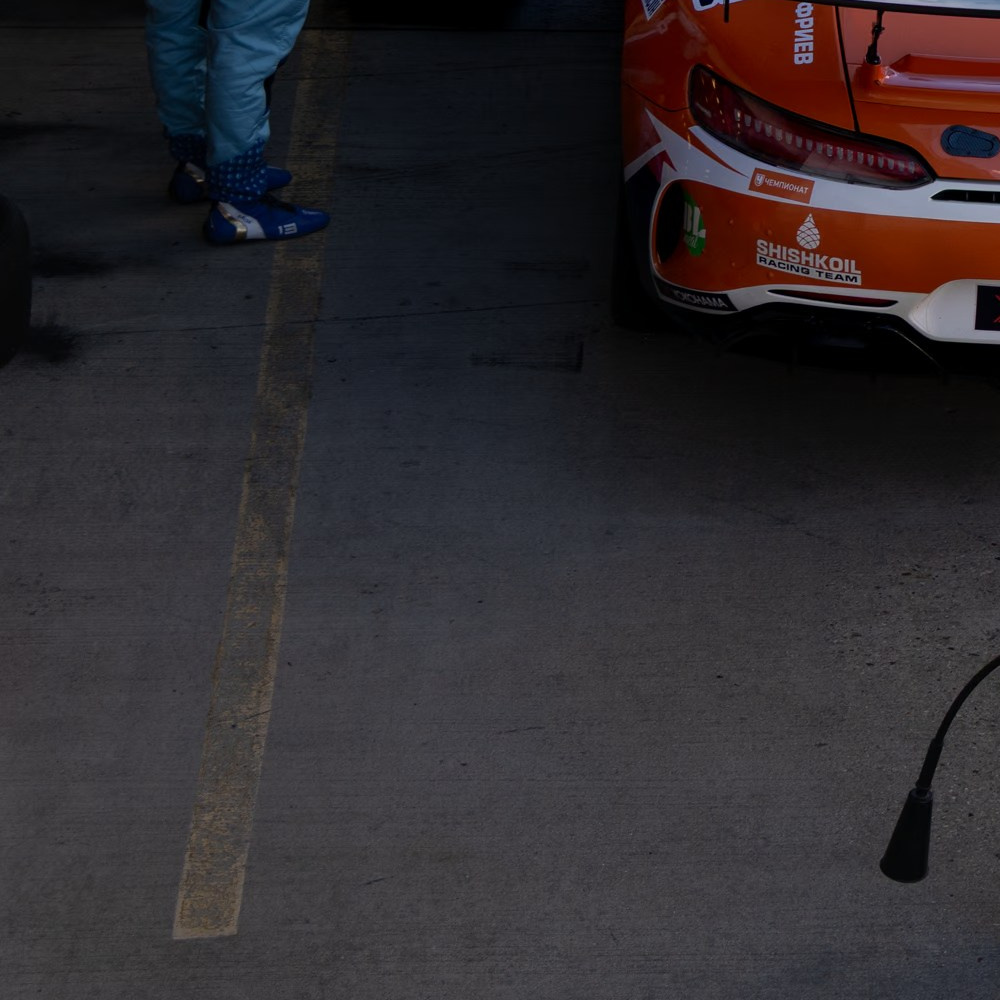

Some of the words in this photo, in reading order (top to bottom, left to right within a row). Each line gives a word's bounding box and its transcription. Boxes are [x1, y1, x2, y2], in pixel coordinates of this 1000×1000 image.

[764, 177, 809, 195] ЧЕМПИОНАТ
[756, 238, 862, 275] SHISHKOIL
[759, 255, 810, 275] RACING
[815, 269, 858, 284] TEAM
